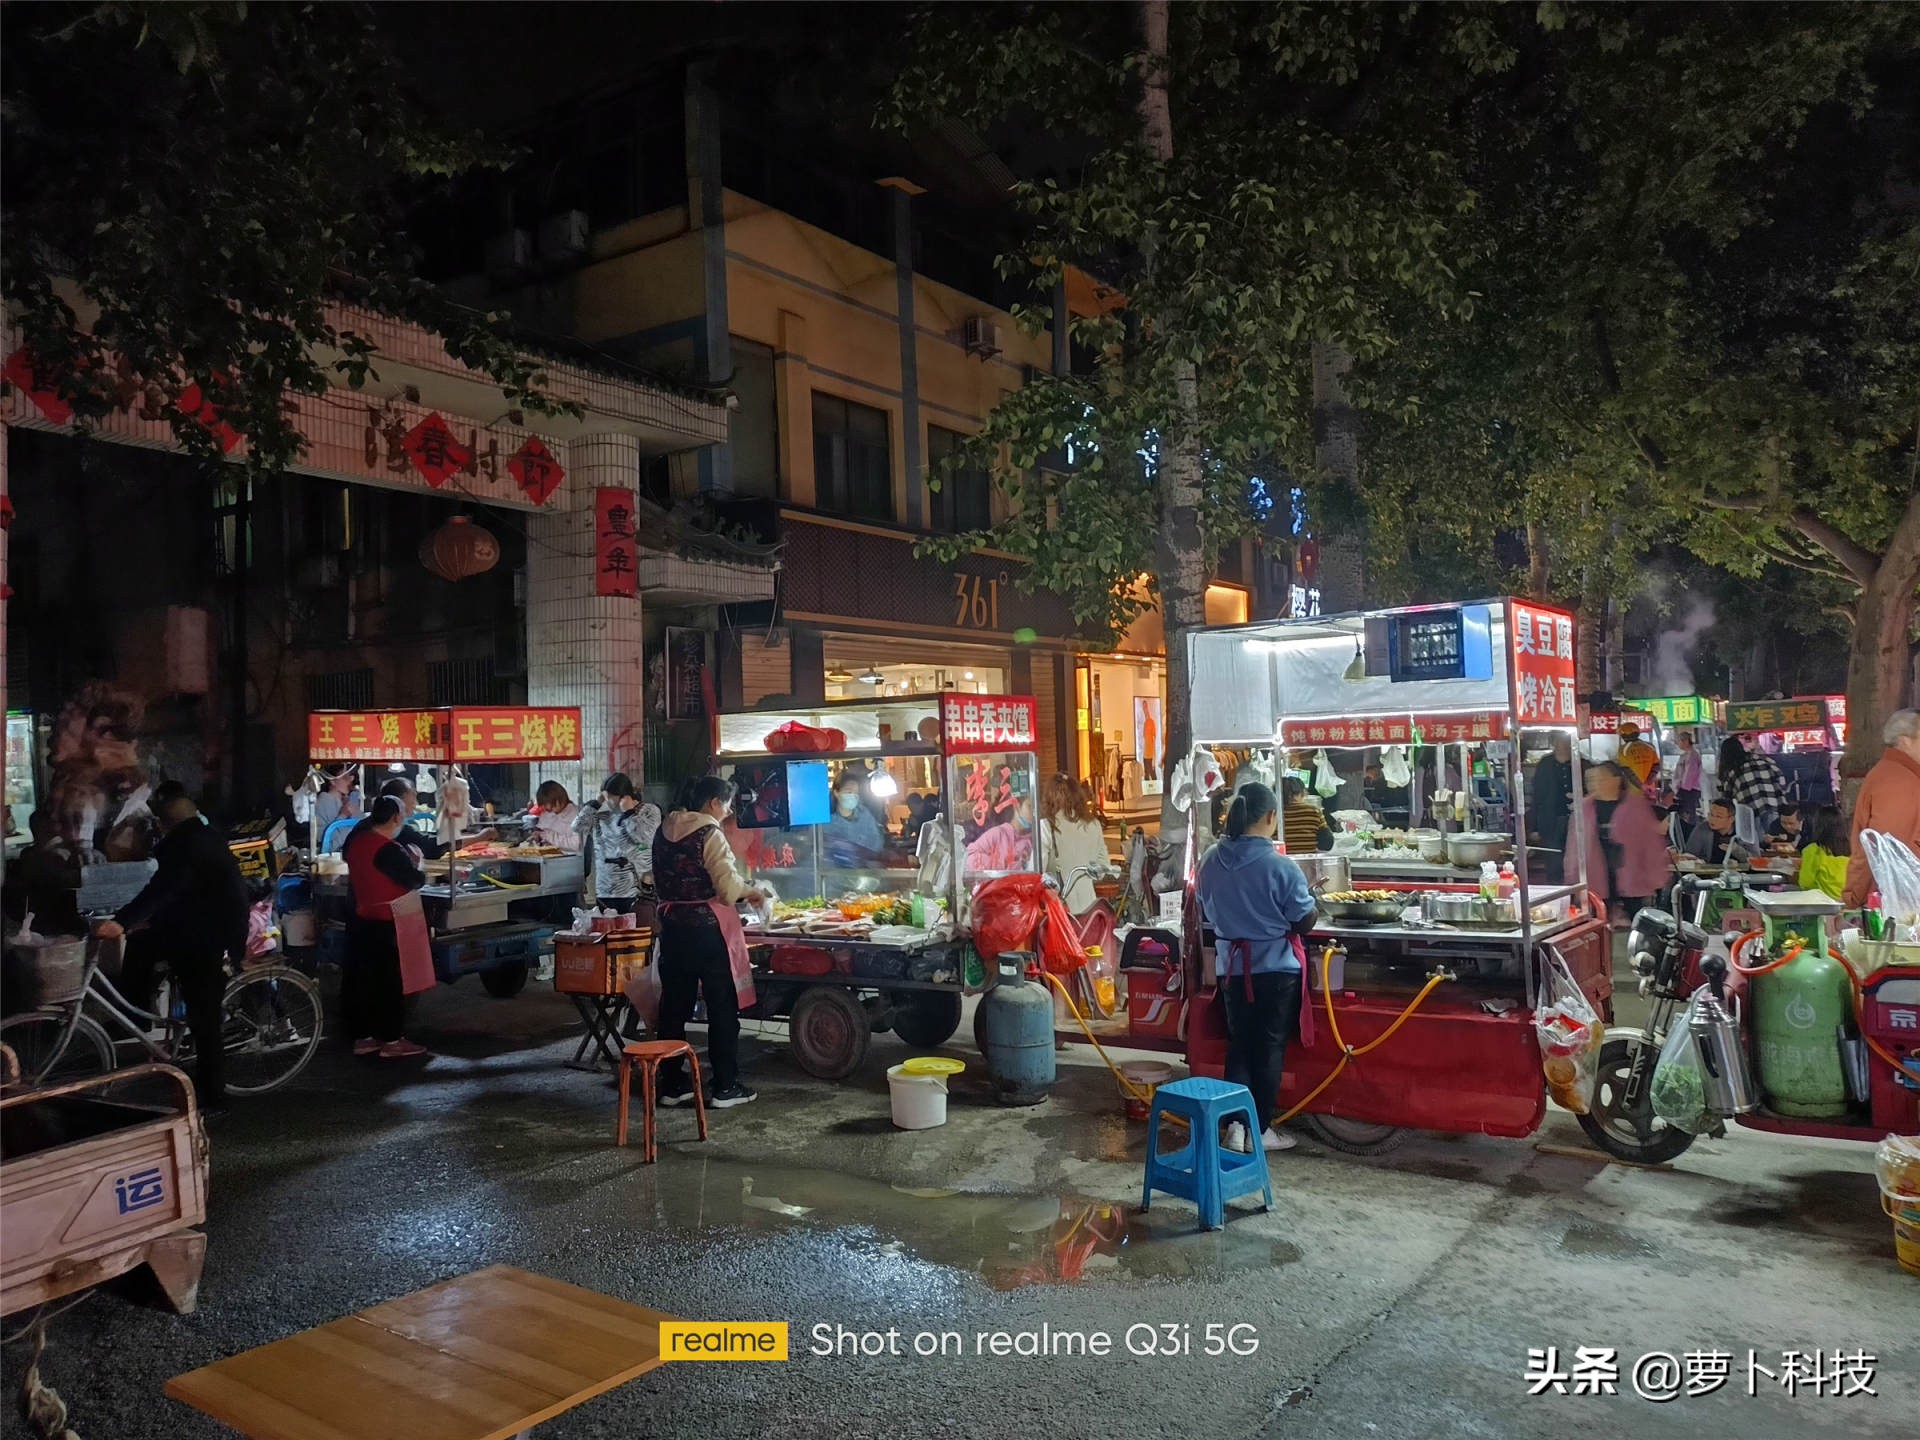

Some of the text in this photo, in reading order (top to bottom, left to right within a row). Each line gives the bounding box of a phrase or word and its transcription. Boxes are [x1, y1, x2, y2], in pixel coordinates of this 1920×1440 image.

[1516, 608, 1573, 661] 臭豆腐
[1517, 671, 1577, 719] 烤冷面
[1733, 702, 1820, 729] 炸鸡
[318, 711, 434, 744] 王三烧烤
[456, 713, 577, 758] 王三烧烤
[944, 699, 1031, 745] 串串香夹馍
